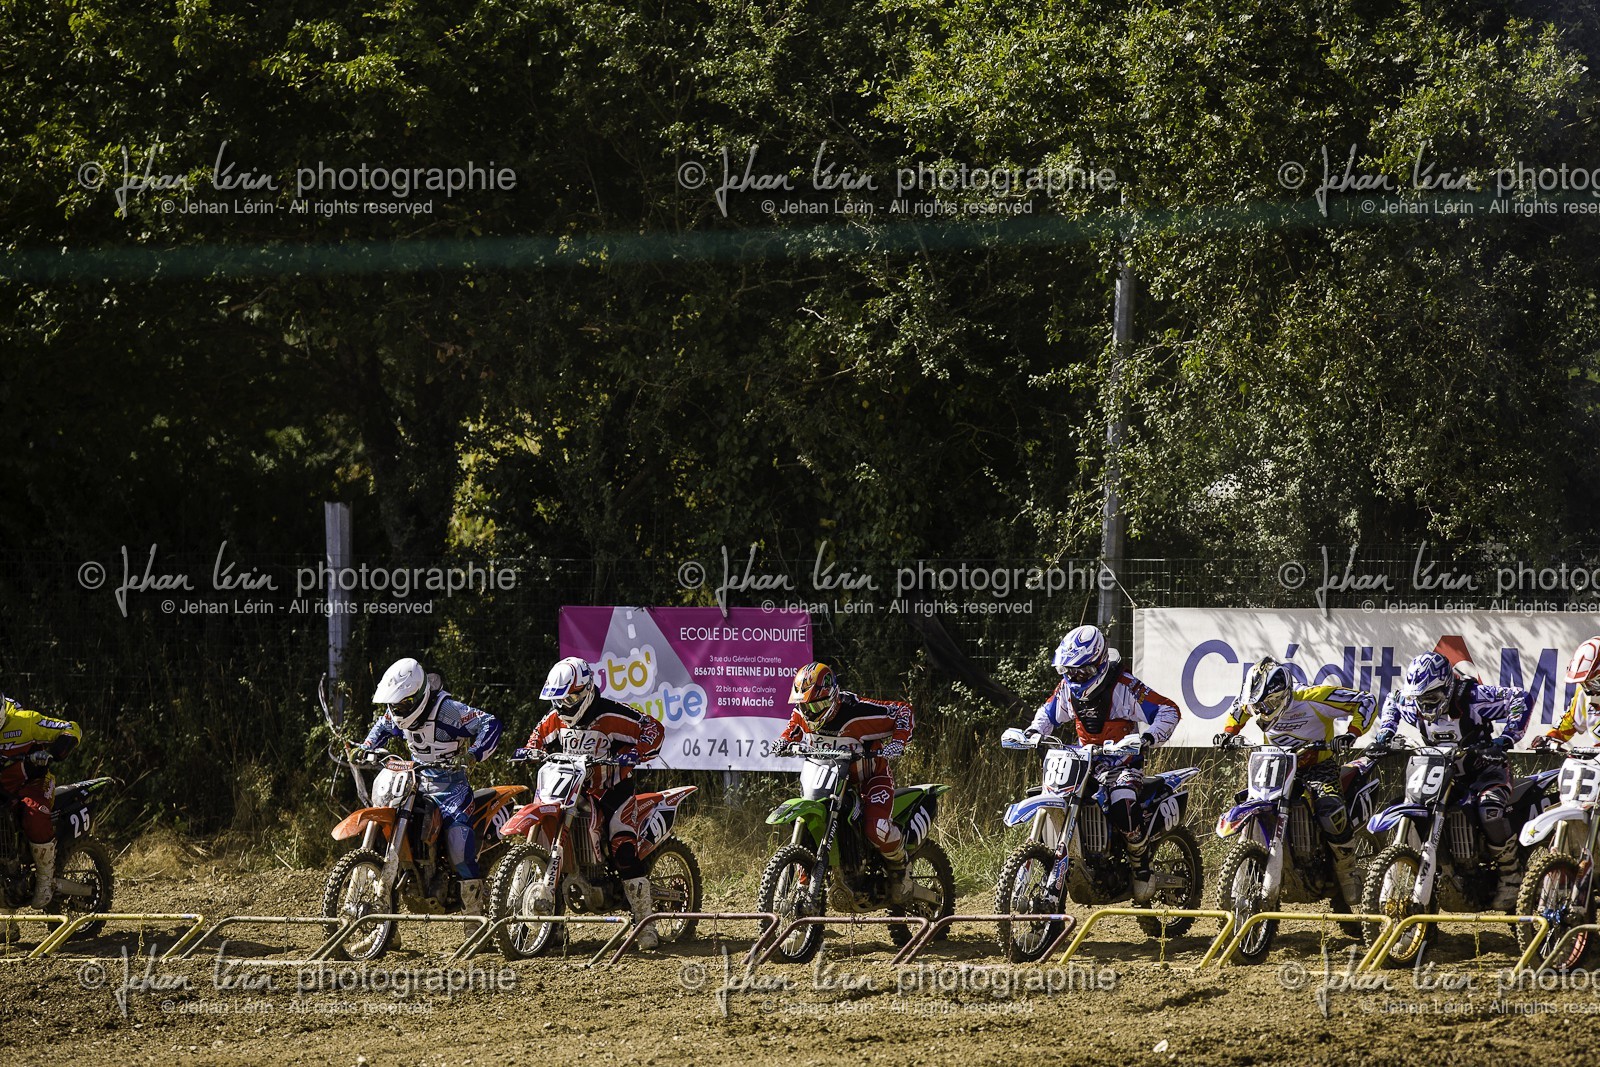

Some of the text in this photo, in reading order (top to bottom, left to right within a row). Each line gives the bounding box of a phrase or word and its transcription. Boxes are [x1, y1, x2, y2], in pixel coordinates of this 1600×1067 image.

[680, 627, 806, 642] ECOLE DE CONDUITE
[694, 666, 799, 678] 85670 St ETIENNE DU BOIS
[709, 655, 714, 663] 3
[723, 655, 732, 663] du
[732, 655, 757, 664] Général
[757, 655, 782, 664] Charette
[723, 685, 732, 693] bis
[751, 685, 777, 694] Calvaire
[1495, 648, 1577, 724] M
[717, 696, 774, 707] 85190 Maché
[682, 738, 701, 757] 06
[707, 738, 729, 757] 74
[735, 739, 755, 758] 17
[1045, 757, 1073, 786] 89
[1254, 757, 1280, 788] 41
[1407, 762, 1444, 795] 49
[70, 807, 90, 839] 25
[910, 805, 931, 846] 101
[1160, 797, 1180, 832] 89
